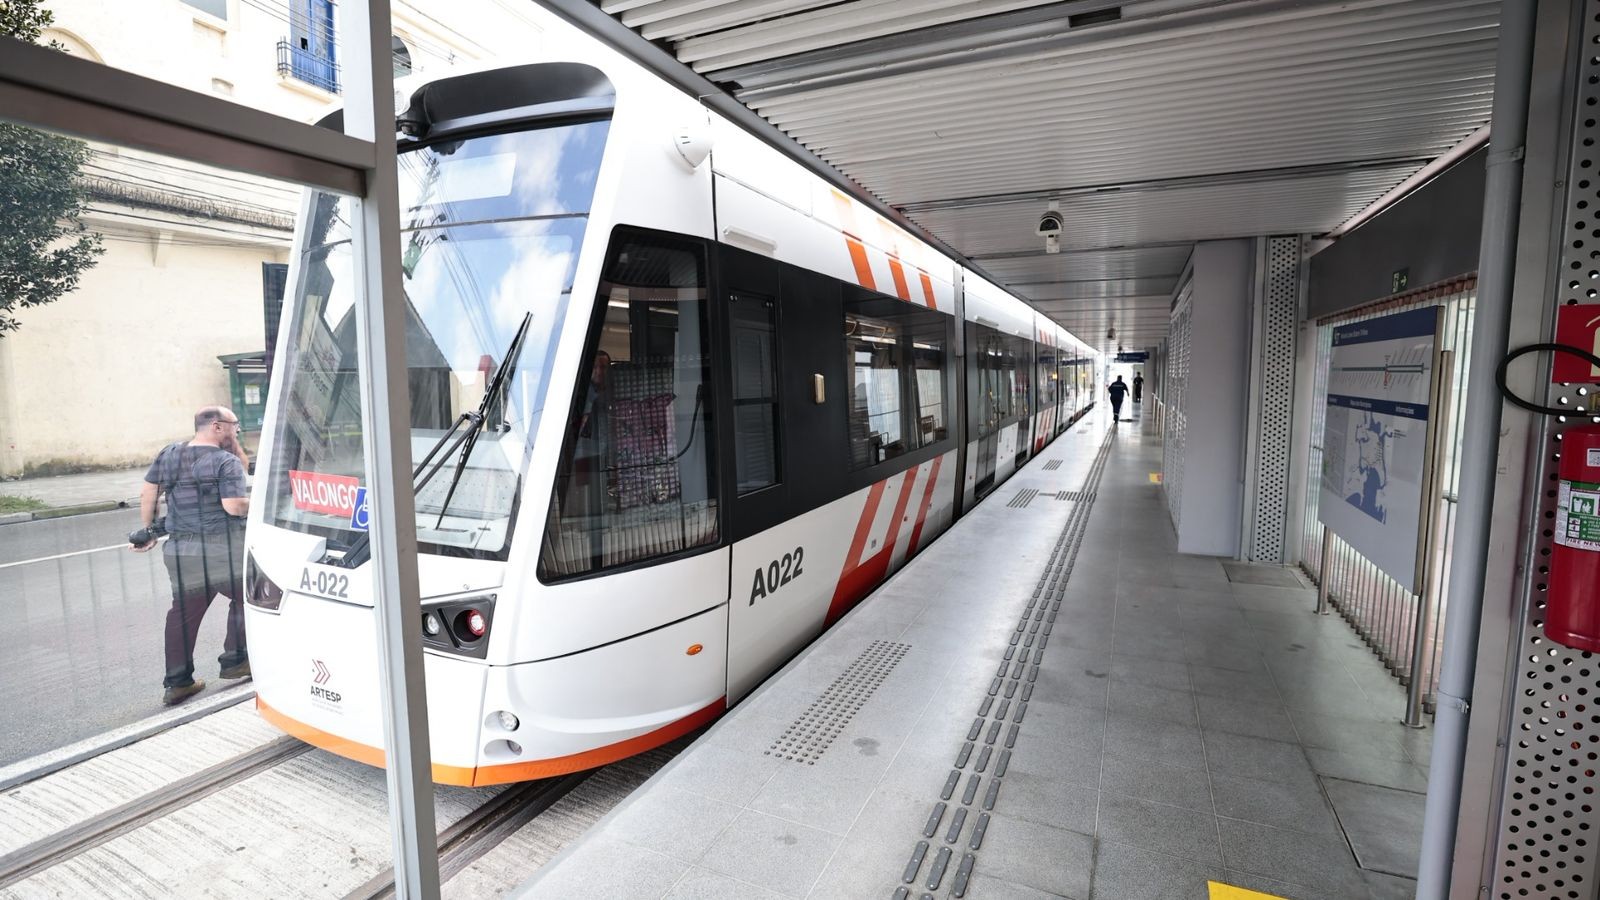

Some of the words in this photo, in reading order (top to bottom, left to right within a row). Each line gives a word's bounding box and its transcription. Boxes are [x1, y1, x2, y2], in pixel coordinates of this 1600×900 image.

[292, 478, 358, 511] VALONGO
[300, 567, 349, 598] A-022
[749, 546, 804, 607] A022
[310, 685, 342, 703] ARTESP
